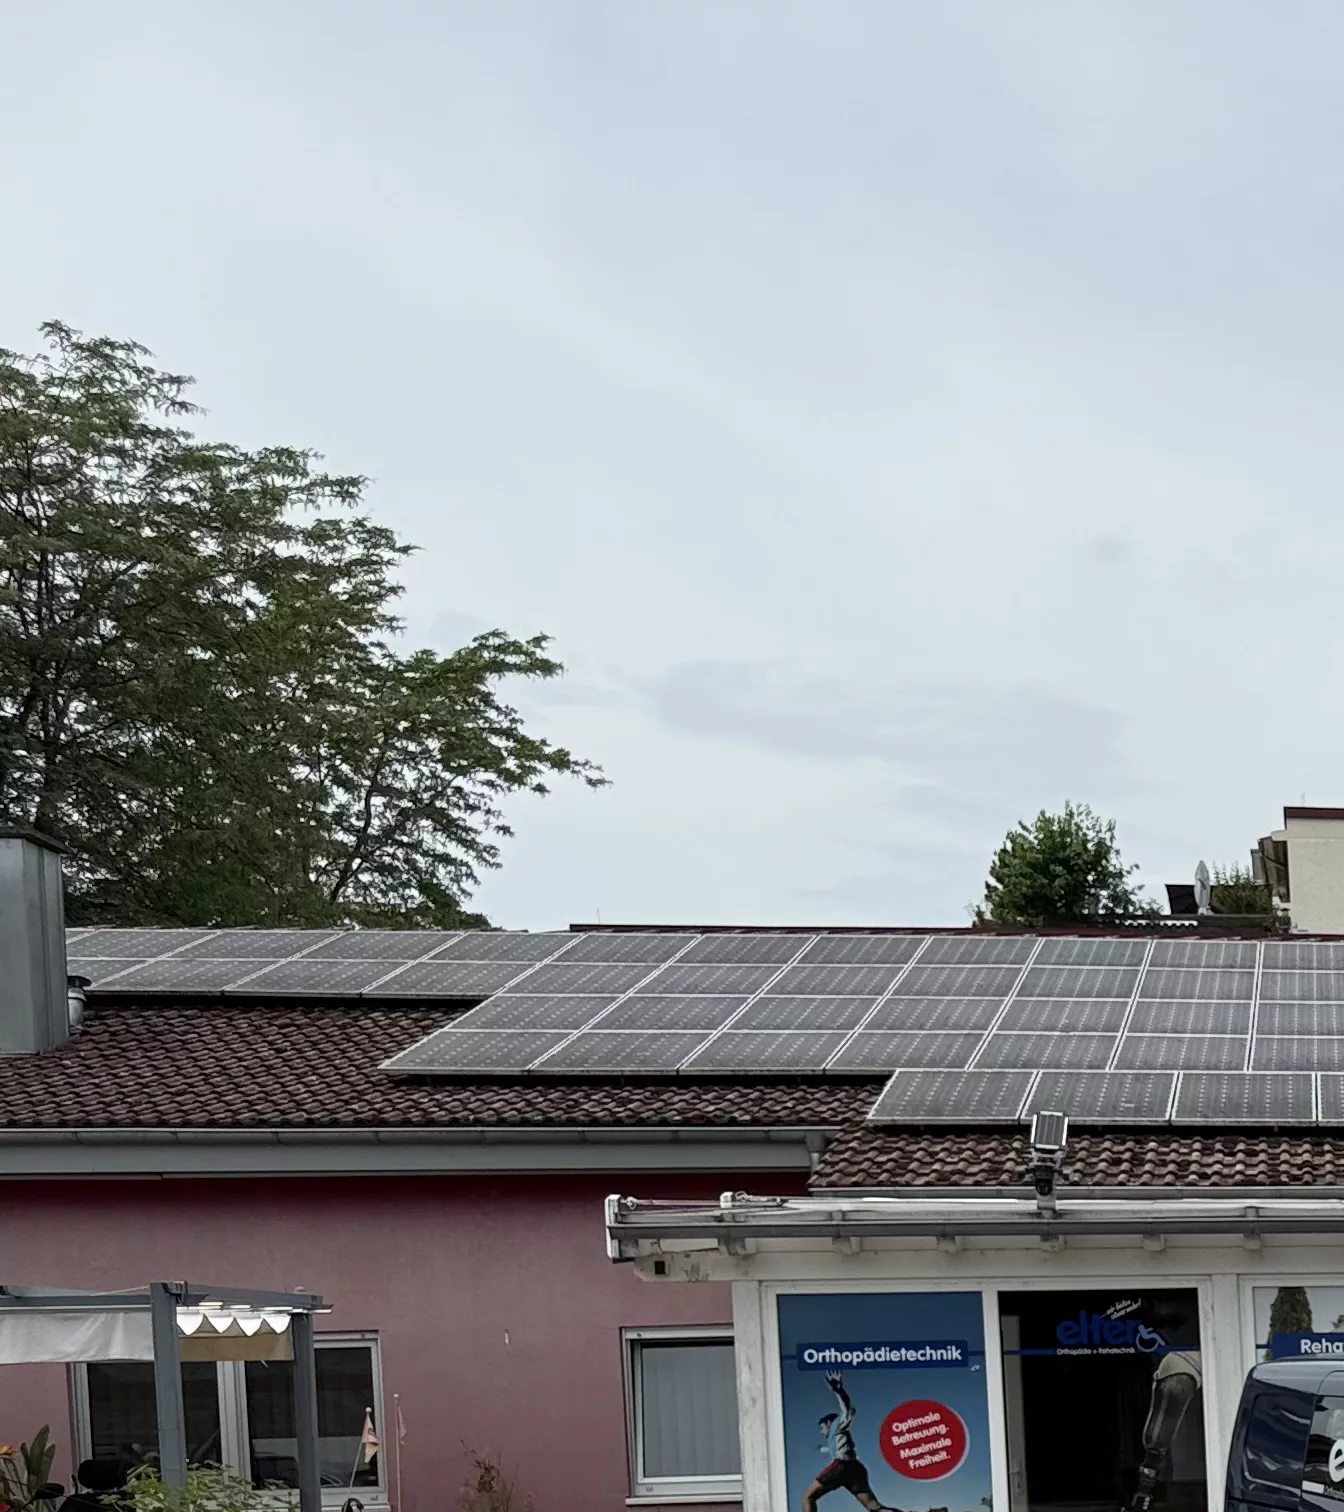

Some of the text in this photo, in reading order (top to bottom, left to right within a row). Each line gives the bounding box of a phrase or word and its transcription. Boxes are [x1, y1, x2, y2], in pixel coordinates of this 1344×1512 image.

[1056, 1310, 1139, 1344] elter
[804, 1345, 962, 1366] Orthopädietechnik
[892, 1412, 940, 1433] Optimale
[900, 1438, 952, 1459] Maximale
